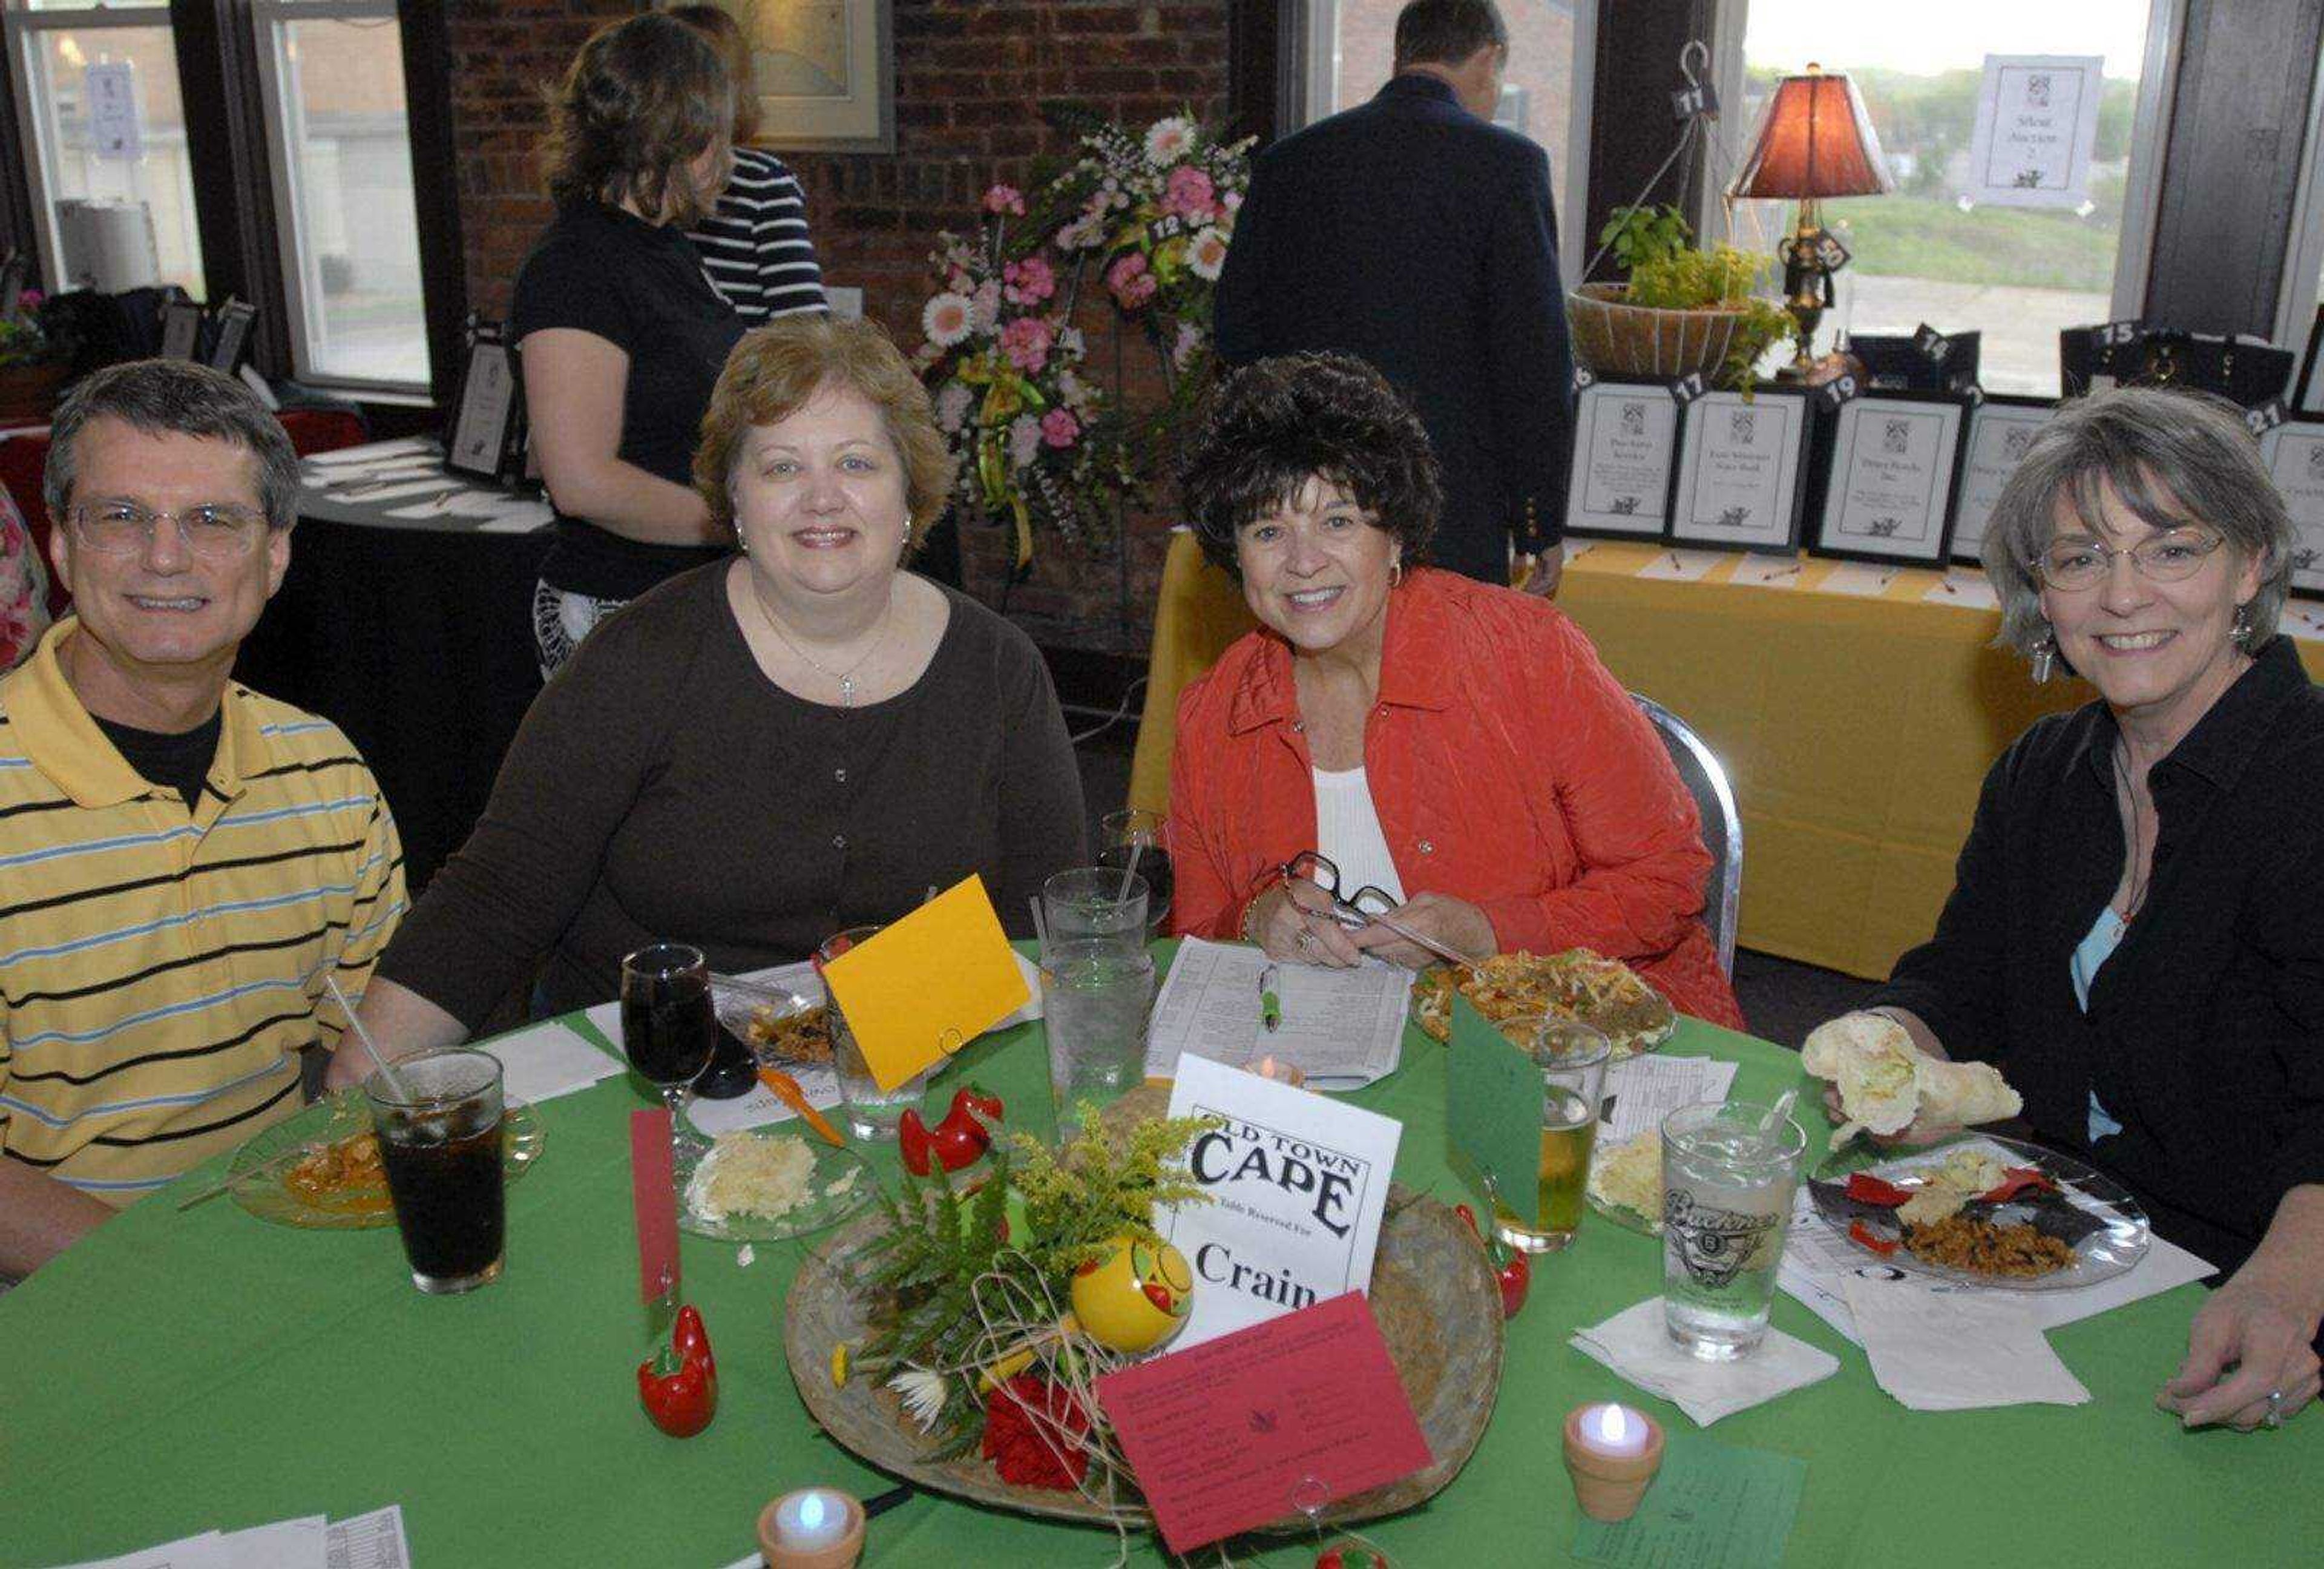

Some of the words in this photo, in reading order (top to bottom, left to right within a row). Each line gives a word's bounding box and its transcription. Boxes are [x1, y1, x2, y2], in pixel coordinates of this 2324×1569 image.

[2102, 323, 2134, 345] 15
[1271, 1136, 1361, 1176] TOWN
[1191, 1131, 1353, 1239] CAPE
[1196, 1241, 1316, 1311] Crain
